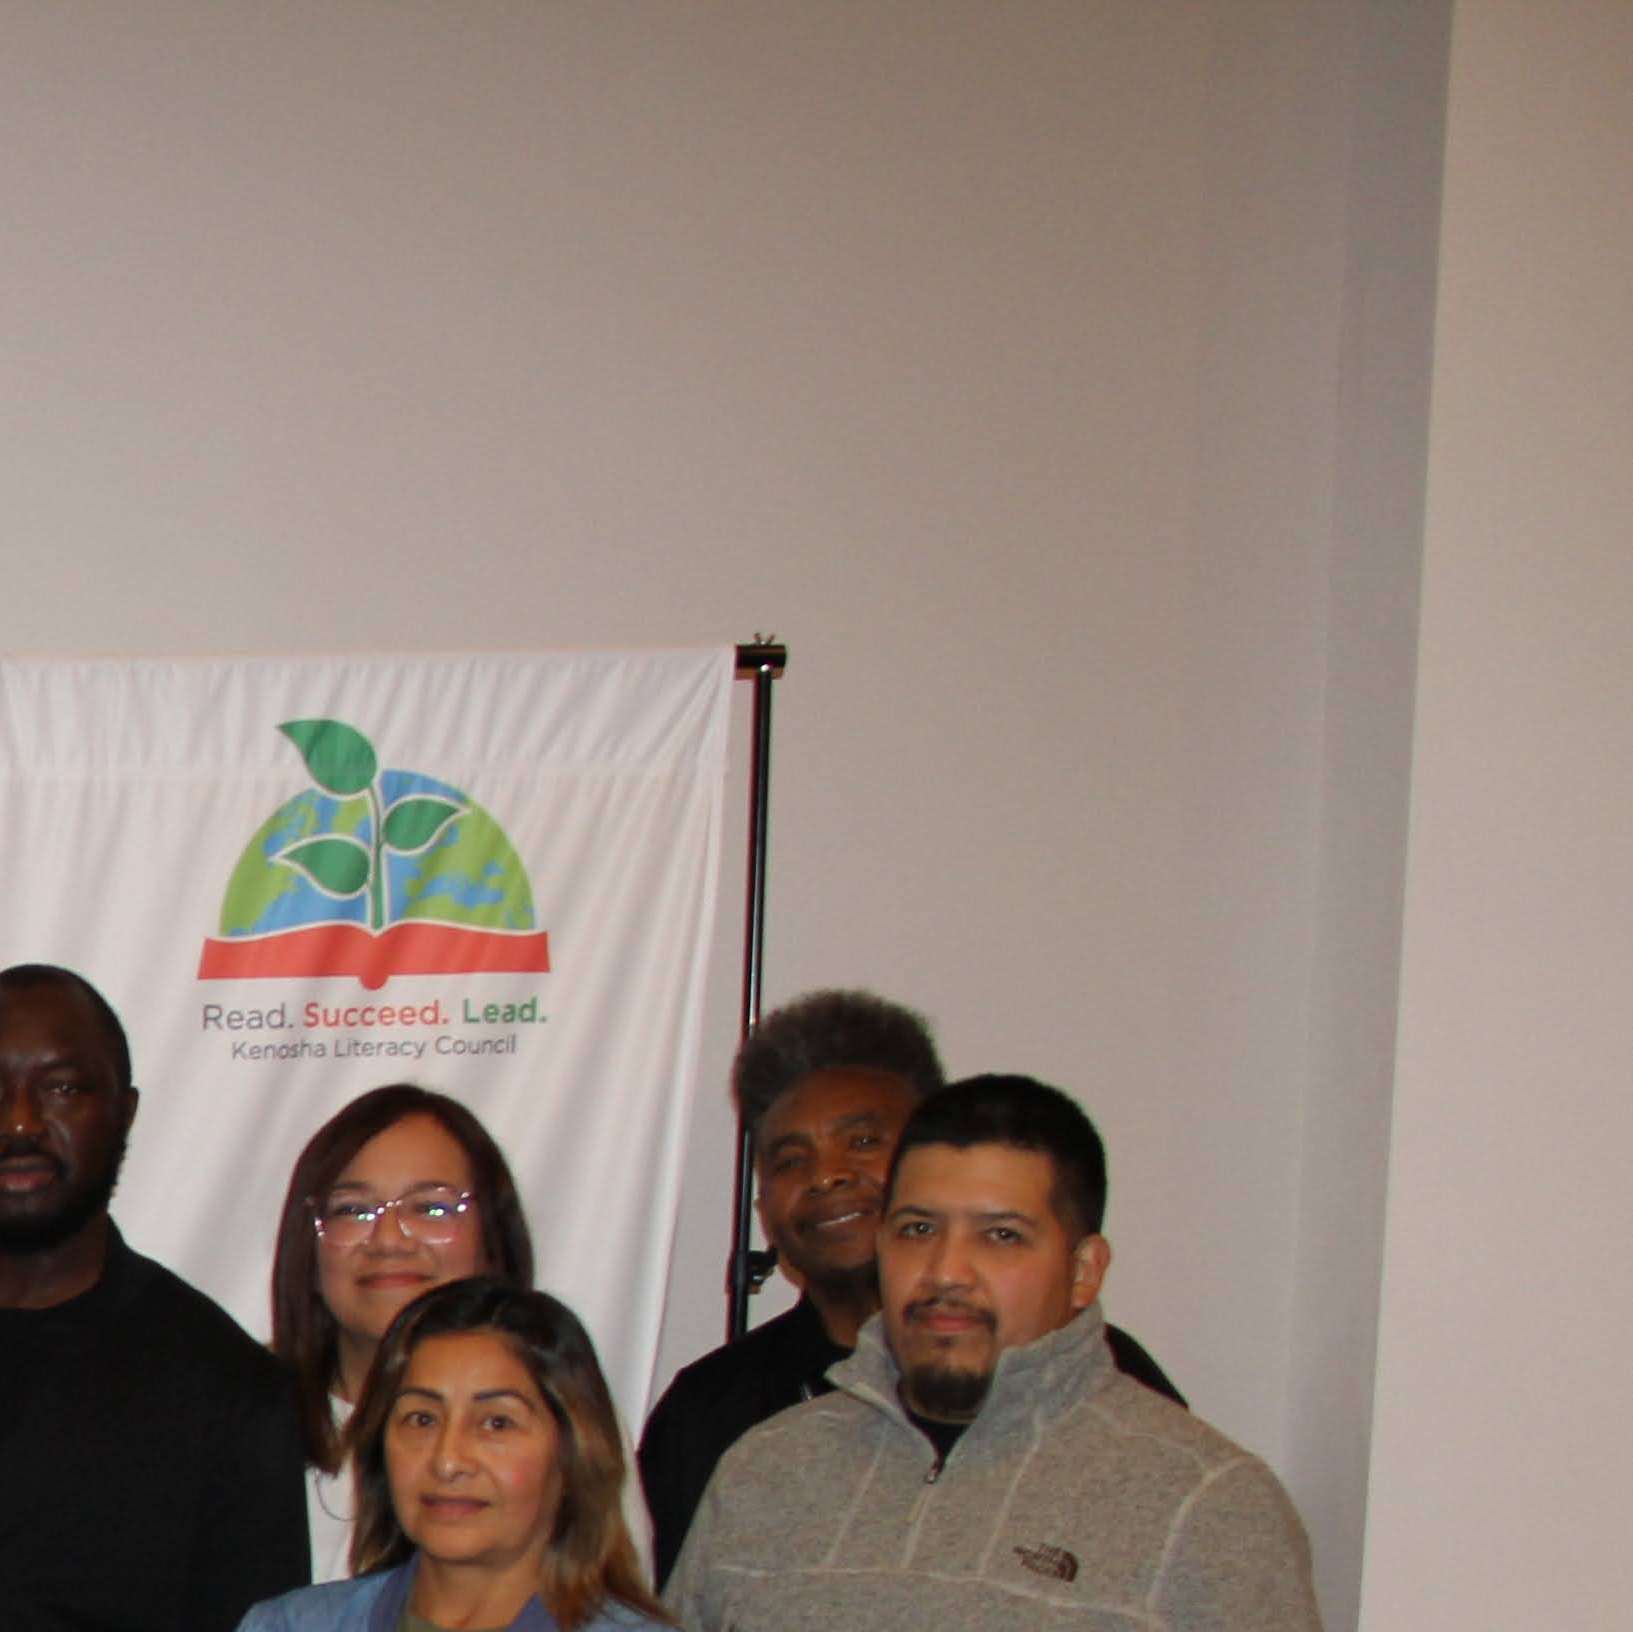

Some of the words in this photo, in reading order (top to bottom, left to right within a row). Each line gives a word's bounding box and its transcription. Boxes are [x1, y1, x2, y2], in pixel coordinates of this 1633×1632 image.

[202, 1002, 294, 1031] Read.
[302, 999, 450, 1029] Succeed.
[462, 995, 548, 1024] Lead.
[231, 1039, 327, 1061] Kenosha
[335, 1037, 427, 1059] Literacy
[435, 1033, 518, 1055] Council
